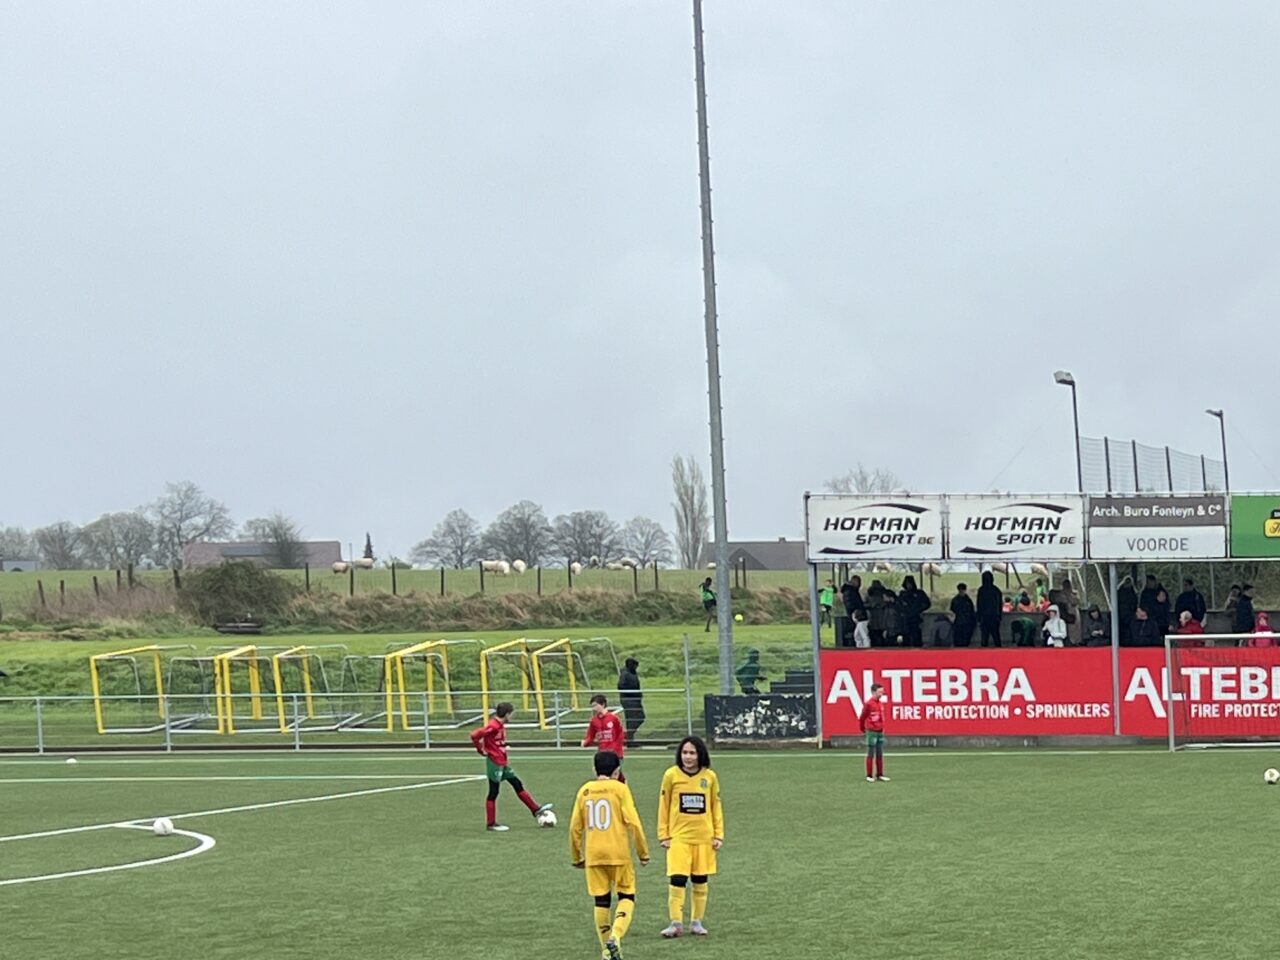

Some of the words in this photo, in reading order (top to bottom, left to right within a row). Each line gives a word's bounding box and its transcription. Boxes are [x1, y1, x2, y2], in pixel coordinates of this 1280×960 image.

[1093, 506, 1121, 517] Arch.
[1123, 506, 1150, 517] Buro
[1152, 505, 1194, 518] Fonteyn
[1196, 505, 1206, 516] &
[824, 517, 920, 531] HOFMAN
[965, 517, 1062, 531] HOFMAN
[855, 533, 916, 545] SPORT
[996, 533, 1058, 545] SPORT
[1126, 537, 1189, 552] VOORDE
[827, 667, 1036, 719] ALTEBRA
[893, 705, 921, 720] FIRE
[925, 704, 1009, 719] PROTECTION
[1026, 703, 1110, 718] SPRINKLERS
[1191, 703, 1220, 718] FIRE
[586, 799, 611, 831] 10
